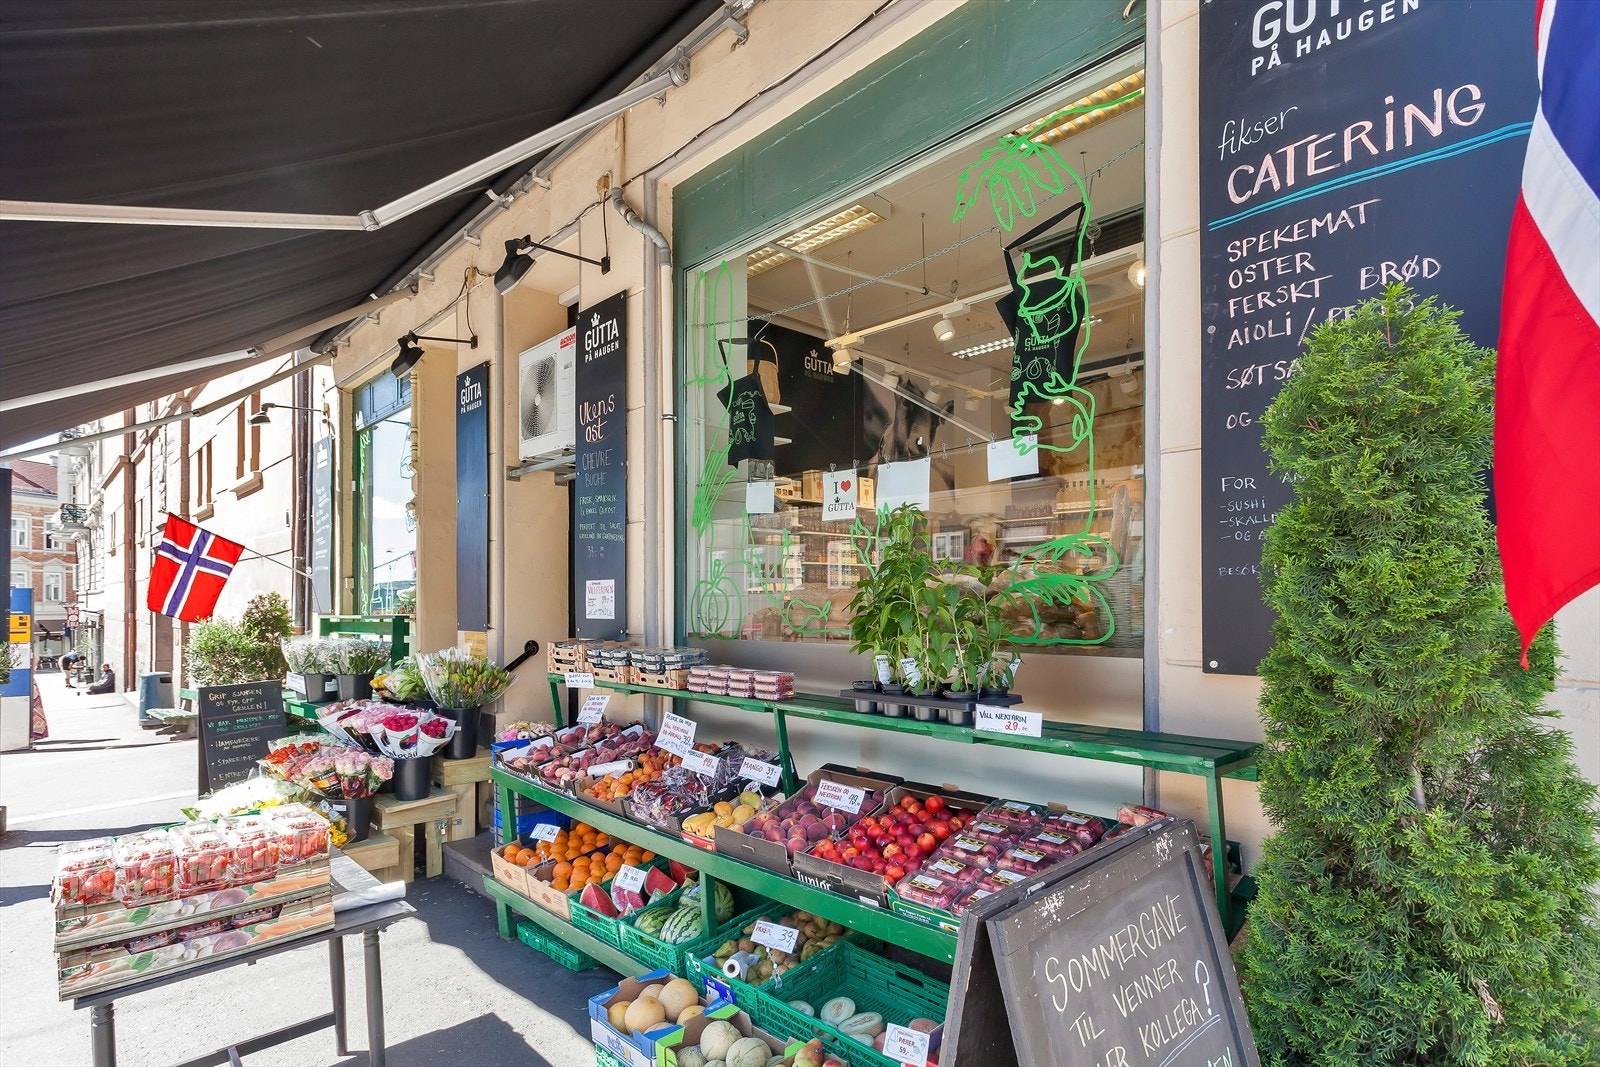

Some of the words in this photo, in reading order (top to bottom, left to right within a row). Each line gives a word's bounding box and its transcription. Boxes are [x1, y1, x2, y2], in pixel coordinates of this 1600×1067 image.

[1251, 43, 1282, 77] PÅ
[1296, 0, 1419, 58] HAUGEN
[1217, 105, 1298, 161] fikser
[1226, 198, 1382, 262] SPEKEMAT
[1228, 252, 1317, 289] OSTER
[1228, 275, 1334, 318] FERSKT
[1360, 255, 1442, 291] BRØD
[584, 317, 619, 352] GUTTA
[584, 350, 593, 364] PÅ
[594, 340, 620, 360] HAUGEN
[804, 355, 834, 376] GUTTA
[460, 381, 482, 405] GUTTA
[460, 404, 467, 415] PÅ
[466, 400, 482, 412] HAUGEN
[585, 417, 608, 443] ost
[1225, 412, 1252, 430] OG
[833, 481, 839, 495] I
[1221, 476, 1257, 492] FOR
[827, 501, 855, 513] GUTTA
[1234, 530, 1251, 541] OG
[743, 760, 764, 772] MANGO
[1045, 894, 1187, 1013] SOMMERGAVE
[1069, 1011, 1106, 1048] TIL
[1112, 958, 1184, 1018] VENNER
[1138, 998, 1205, 1058] KOLLEGA
